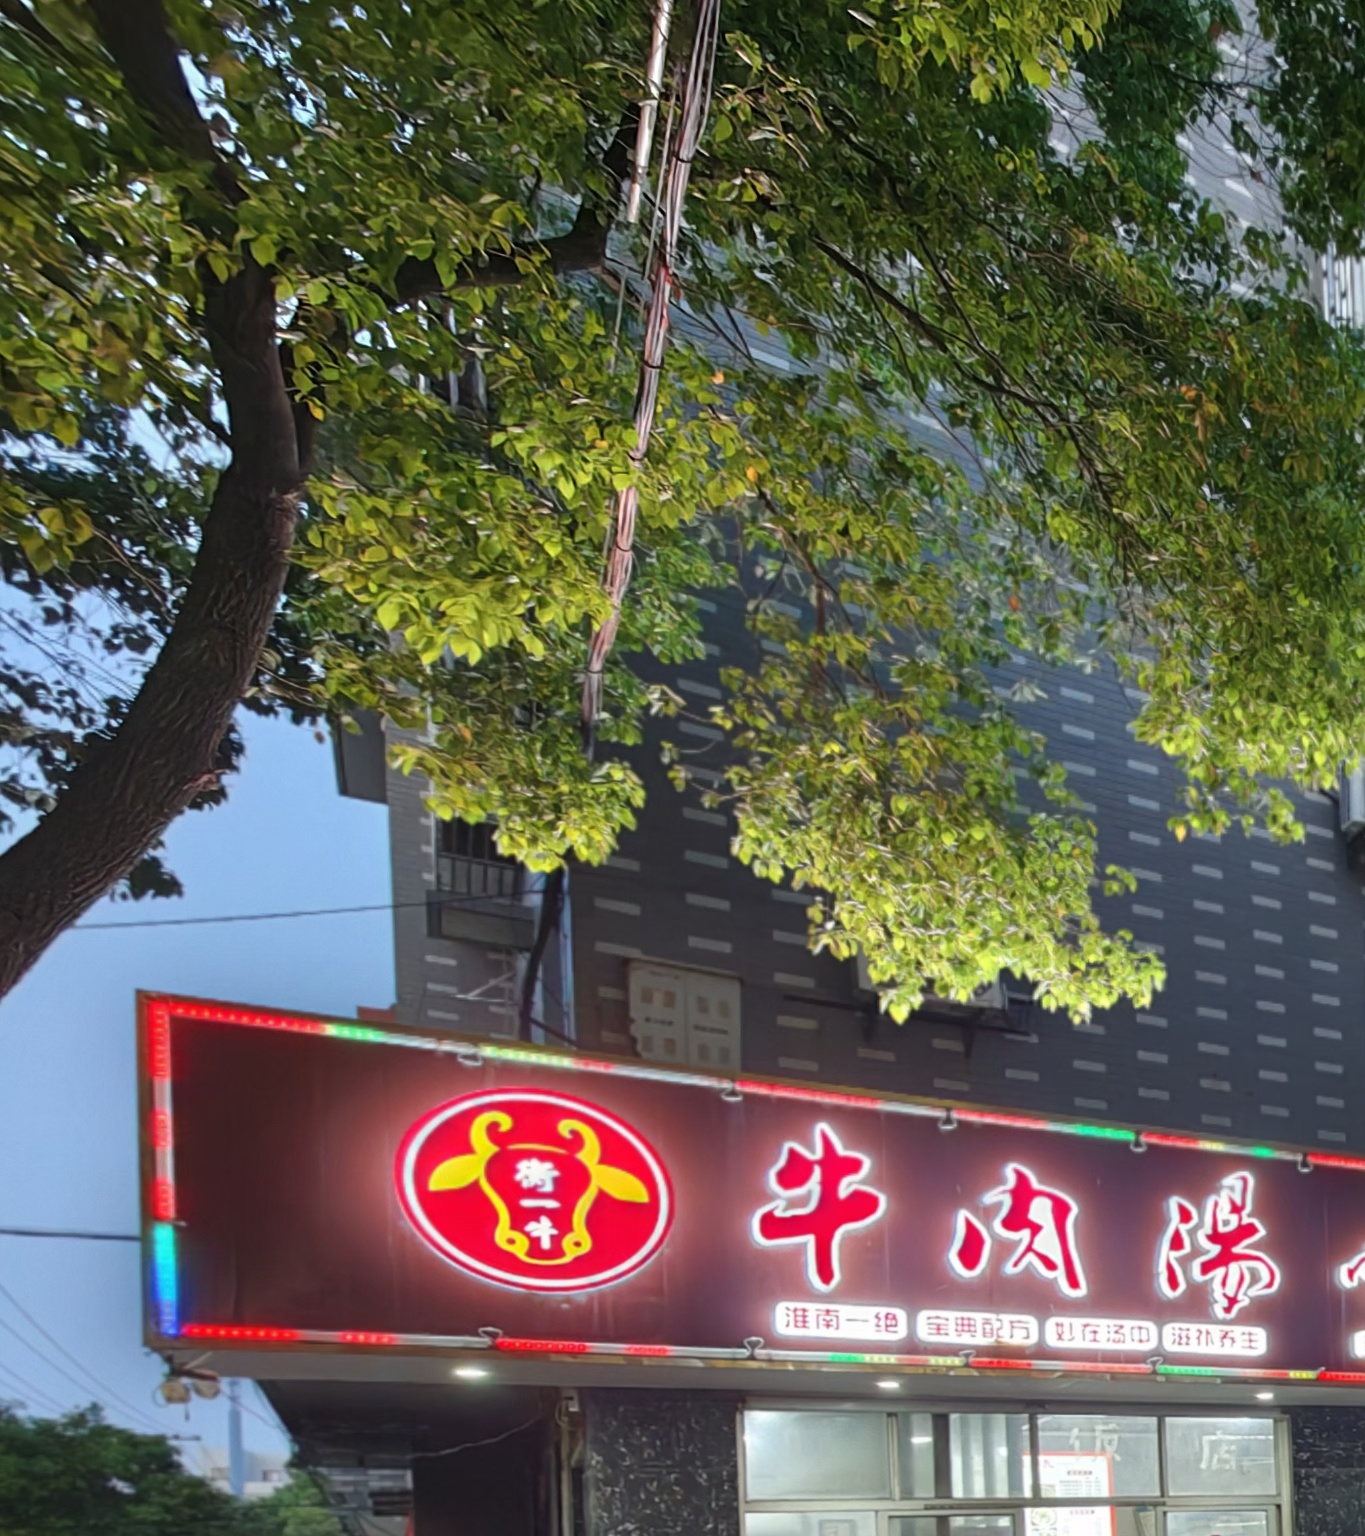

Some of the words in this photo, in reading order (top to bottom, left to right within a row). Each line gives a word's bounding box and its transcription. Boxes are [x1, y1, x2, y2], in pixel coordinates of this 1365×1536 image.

[785, 1306, 900, 1336] 淮南一绝
[926, 1315, 1033, 1342] 宝典配方
